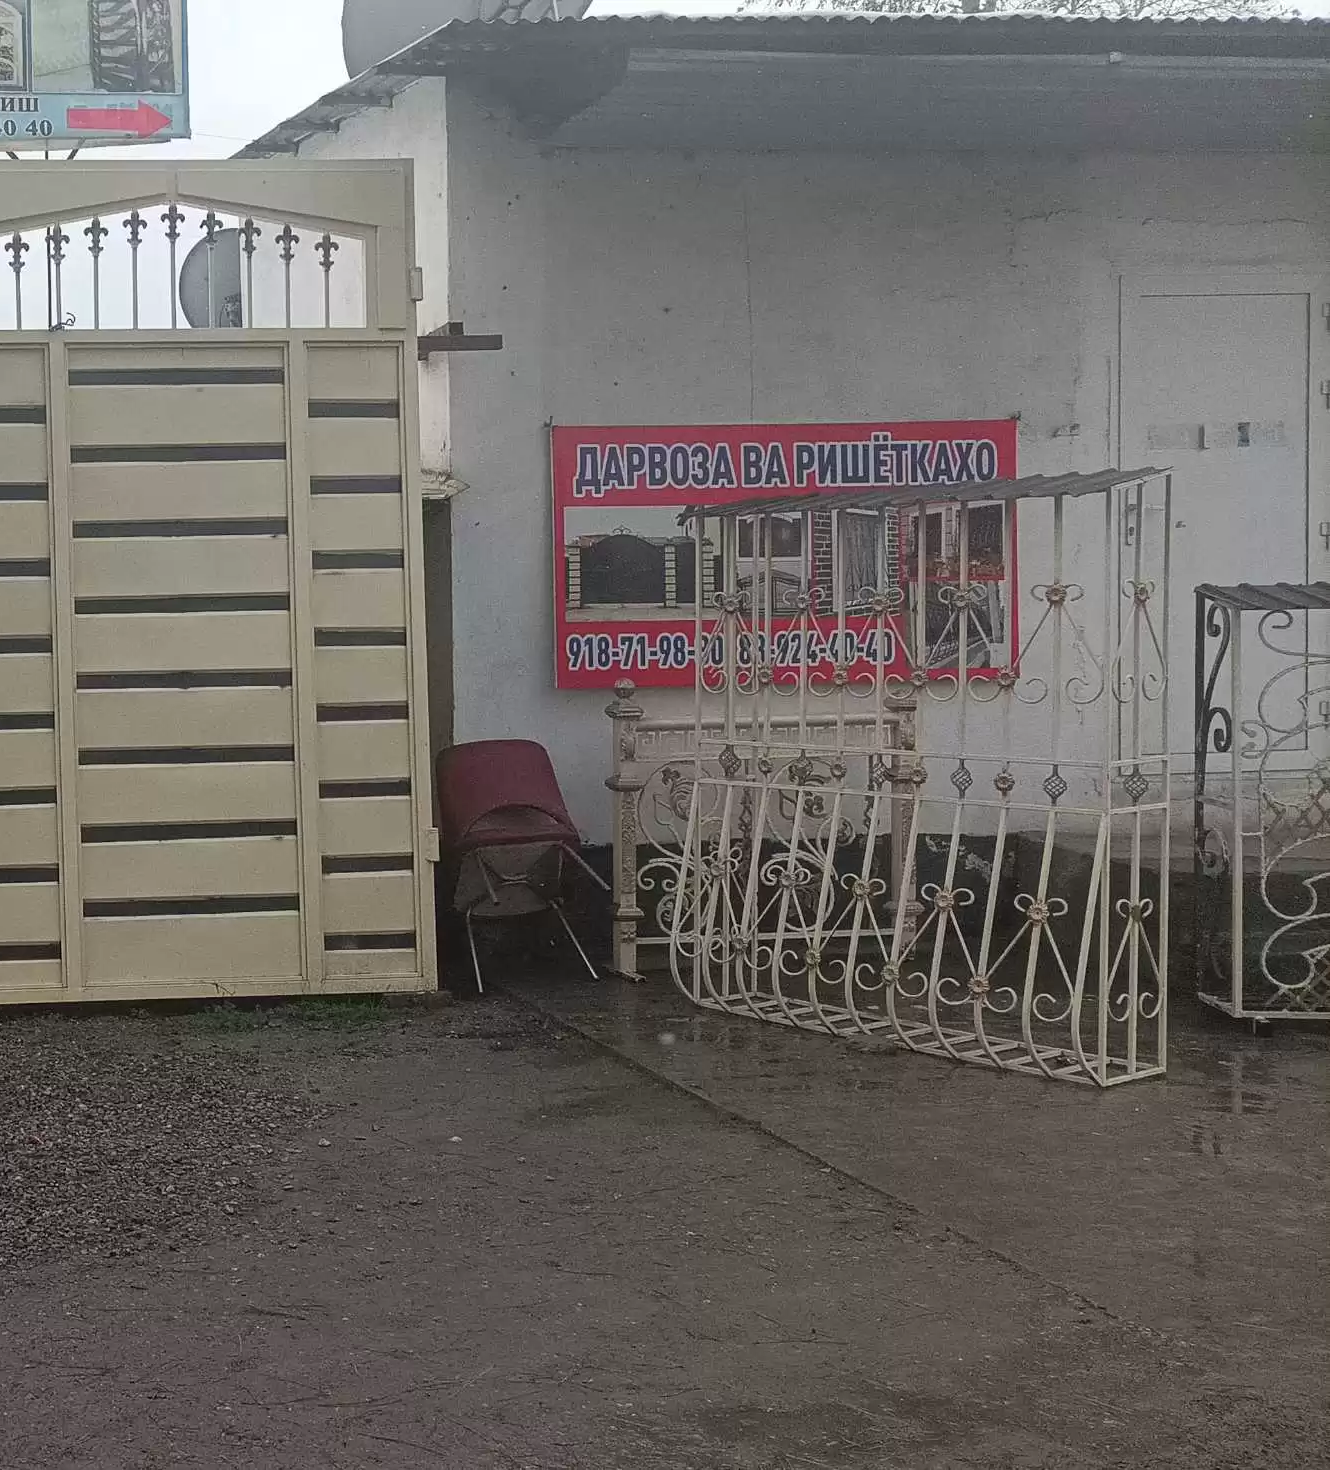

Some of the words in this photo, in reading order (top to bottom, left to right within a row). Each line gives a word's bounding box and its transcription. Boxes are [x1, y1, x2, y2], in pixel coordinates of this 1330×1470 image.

[25, 119, 53, 137] 40
[573, 443, 737, 497] ДАРВОЗА
[741, 443, 789, 488] ВА
[794, 432, 998, 487] РИШЁТКАХО
